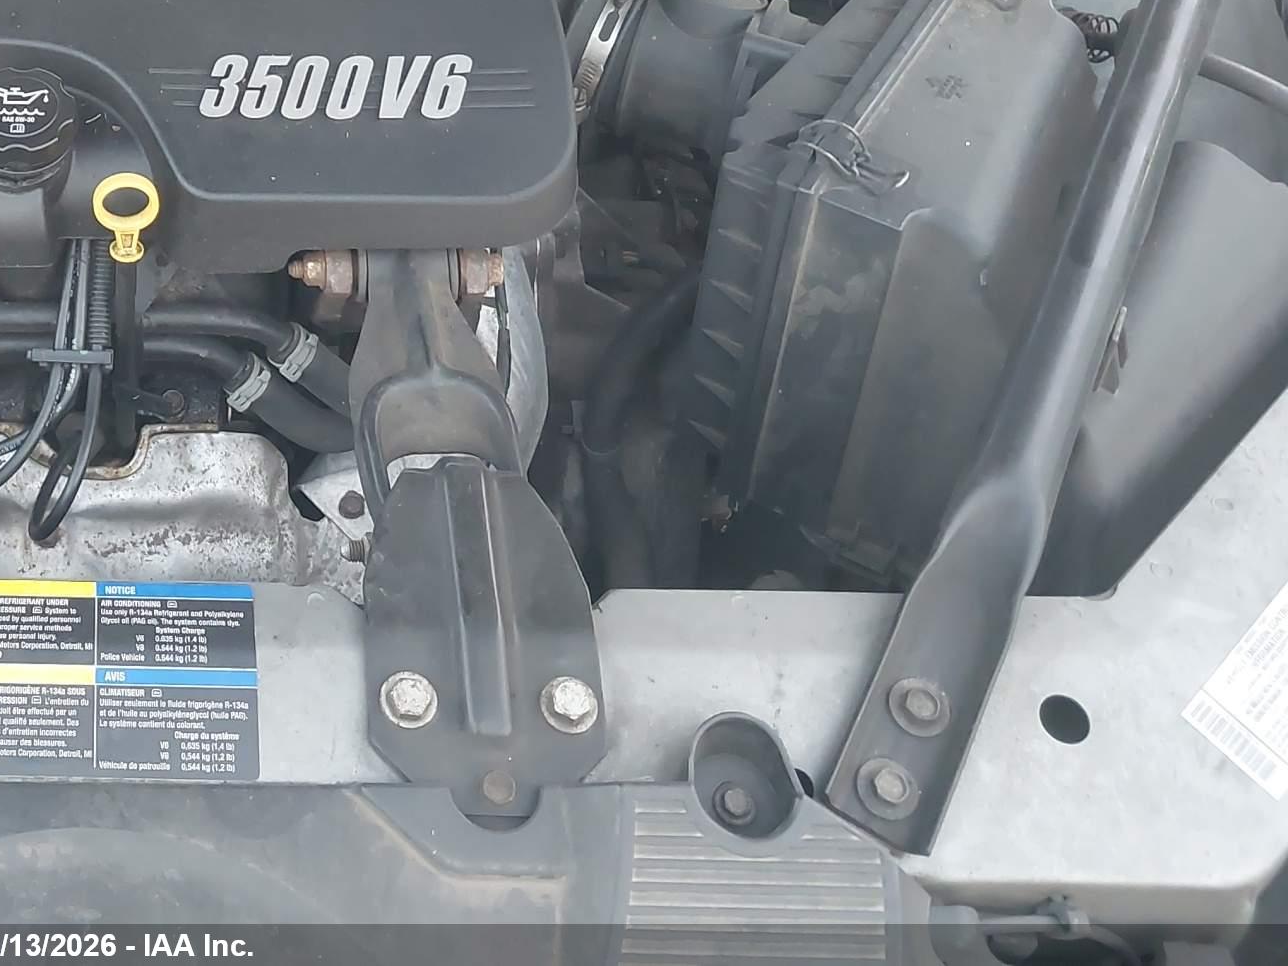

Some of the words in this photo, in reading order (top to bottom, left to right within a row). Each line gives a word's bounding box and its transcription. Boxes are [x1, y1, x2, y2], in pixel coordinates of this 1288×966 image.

[199, 54, 374, 120] 3500
[378, 54, 473, 120] V6
[105, 586, 136, 595] NOTICE
[0, 597, 44, 606] REFRIGERANT
[45, 598, 69, 606] UNDER
[113, 600, 160, 608] CONDITIONING
[45, 607, 68, 616] System
[69, 607, 77, 615] to
[11, 615, 19, 624] by
[20, 615, 48, 624] qualified
[49, 615, 81, 625] personnel
[19, 624, 43, 632] service
[43, 624, 72, 632] methods
[156, 626, 180, 636] System
[181, 627, 205, 636] Charge
[7, 632, 36, 642] personal
[37, 633, 57, 642] injury.
[20, 641, 59, 651] Corporation,
[59, 642, 83, 651] Detroit,
[84, 642, 93, 650] MI
[104, 672, 125, 681] AVIS
[41, 687, 65, 695] R-134a
[66, 688, 85, 696] SOUS
[99, 688, 145, 696] CLIMATISEUR
[17, 749, 57, 758] Corporation,
[58, 750, 82, 759] Detroit,
[83, 750, 92, 758] MI
